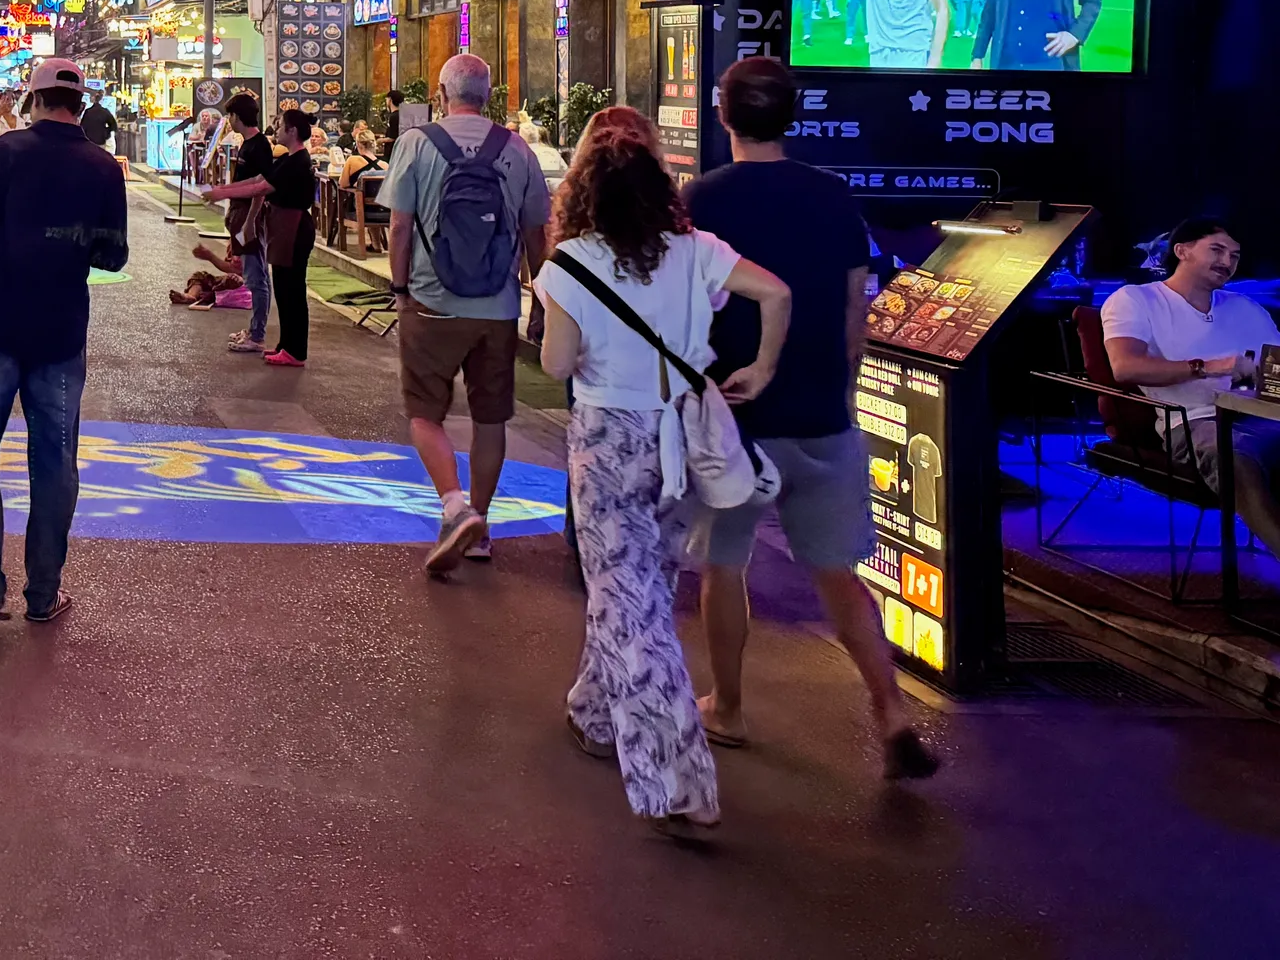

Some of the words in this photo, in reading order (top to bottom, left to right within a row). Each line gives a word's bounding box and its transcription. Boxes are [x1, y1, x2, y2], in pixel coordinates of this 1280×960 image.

[946, 88, 1052, 111] BEER
[946, 121, 1054, 143] PONG
[894, 175, 992, 189] GAMES...
[906, 562, 939, 608] 1+1
